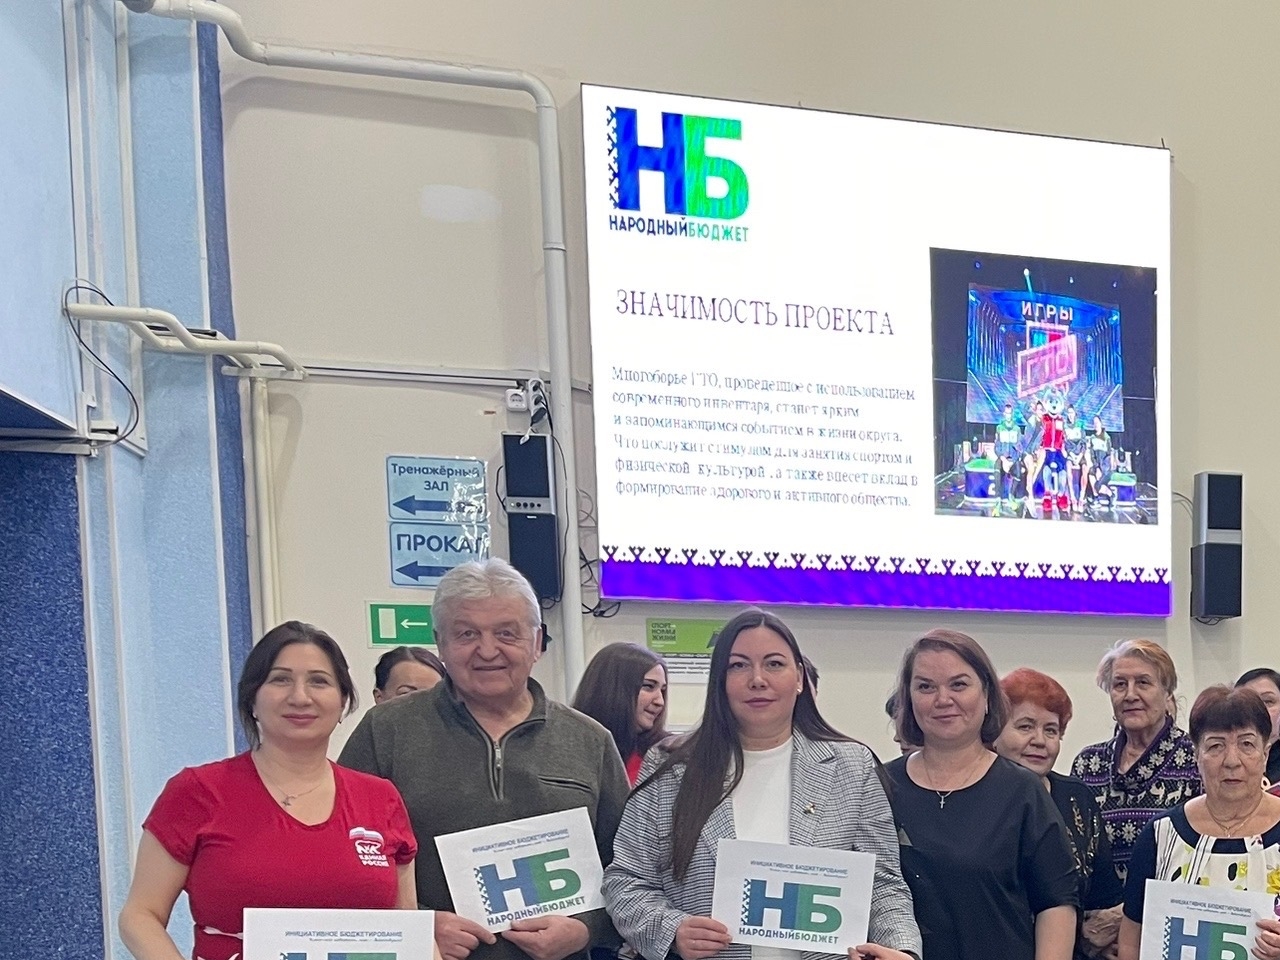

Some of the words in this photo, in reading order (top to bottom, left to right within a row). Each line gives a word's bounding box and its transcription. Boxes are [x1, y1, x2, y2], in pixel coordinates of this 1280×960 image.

[613, 106, 749, 220] НБ
[616, 289, 778, 326] ЗНАЧИМОСТЬ
[785, 303, 895, 335] ПРОЕКТА
[1022, 301, 1073, 321] ИГРЫ
[612, 366, 687, 386] Многоборье
[806, 383, 813, 393] с
[612, 392, 701, 407] современного
[822, 406, 859, 419] ярким
[613, 414, 621, 425] и
[626, 416, 738, 432] запоминающимся
[806, 427, 814, 436] в
[614, 434, 638, 448] Что
[905, 454, 912, 464] и
[615, 457, 690, 474] физической
[786, 468, 824, 481] также
[871, 473, 908, 486] вклад
[911, 475, 918, 486] в
[424, 481, 449, 491] ЗАЛ
[773, 490, 781, 500] и
[479, 848, 582, 915] НБ
[747, 879, 842, 934] НБ
